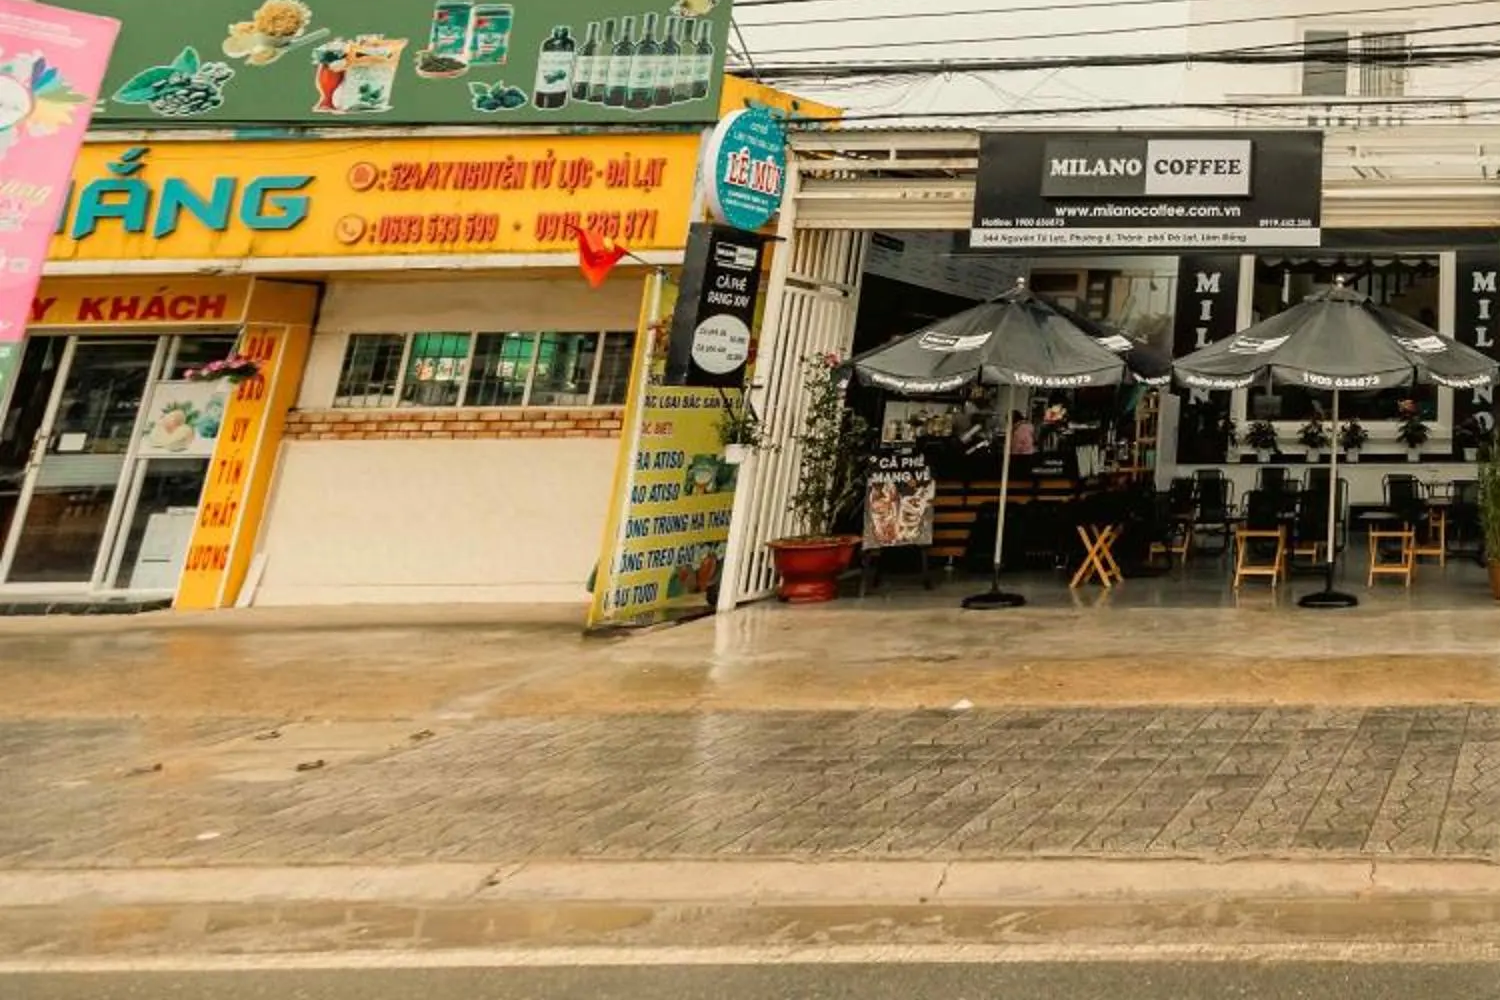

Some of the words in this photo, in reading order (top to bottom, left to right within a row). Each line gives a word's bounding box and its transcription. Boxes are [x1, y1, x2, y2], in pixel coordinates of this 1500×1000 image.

[725, 146, 750, 188] LÊ
[1049, 158, 1143, 177] MILANO
[1154, 159, 1241, 177] COFFEE
[54, 147, 316, 240] ẮNG
[1055, 203, 1241, 218] www.milanocoffee.com.vn
[31, 296, 57, 321] Y
[77, 286, 228, 322] KHÁCH
[631, 484, 647, 504] AO
[625, 515, 649, 539] ÔNG
